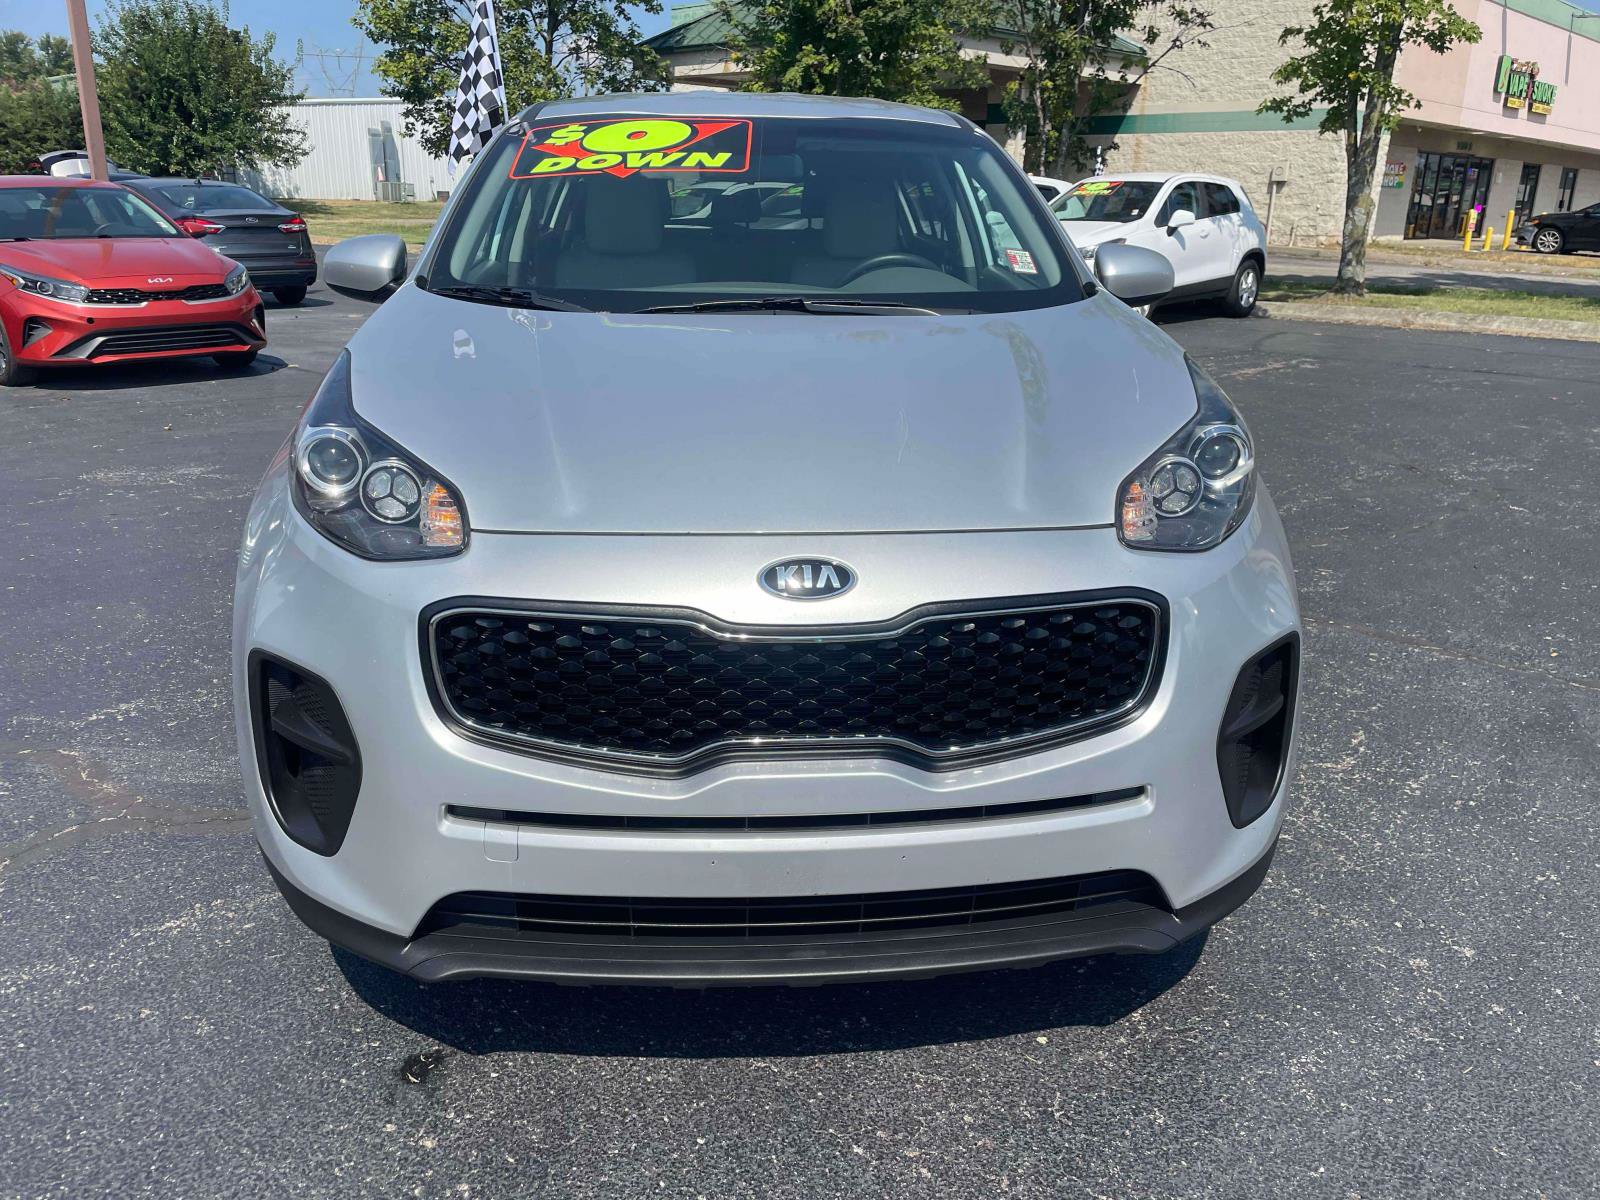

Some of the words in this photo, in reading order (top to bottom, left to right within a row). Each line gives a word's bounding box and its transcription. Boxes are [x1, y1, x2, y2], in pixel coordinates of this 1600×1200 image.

[1509, 72, 1529, 98] VAPE
[1532, 80, 1557, 104] SMOKE
[530, 152, 732, 173] DOWN
[776, 565, 841, 589] KIA
